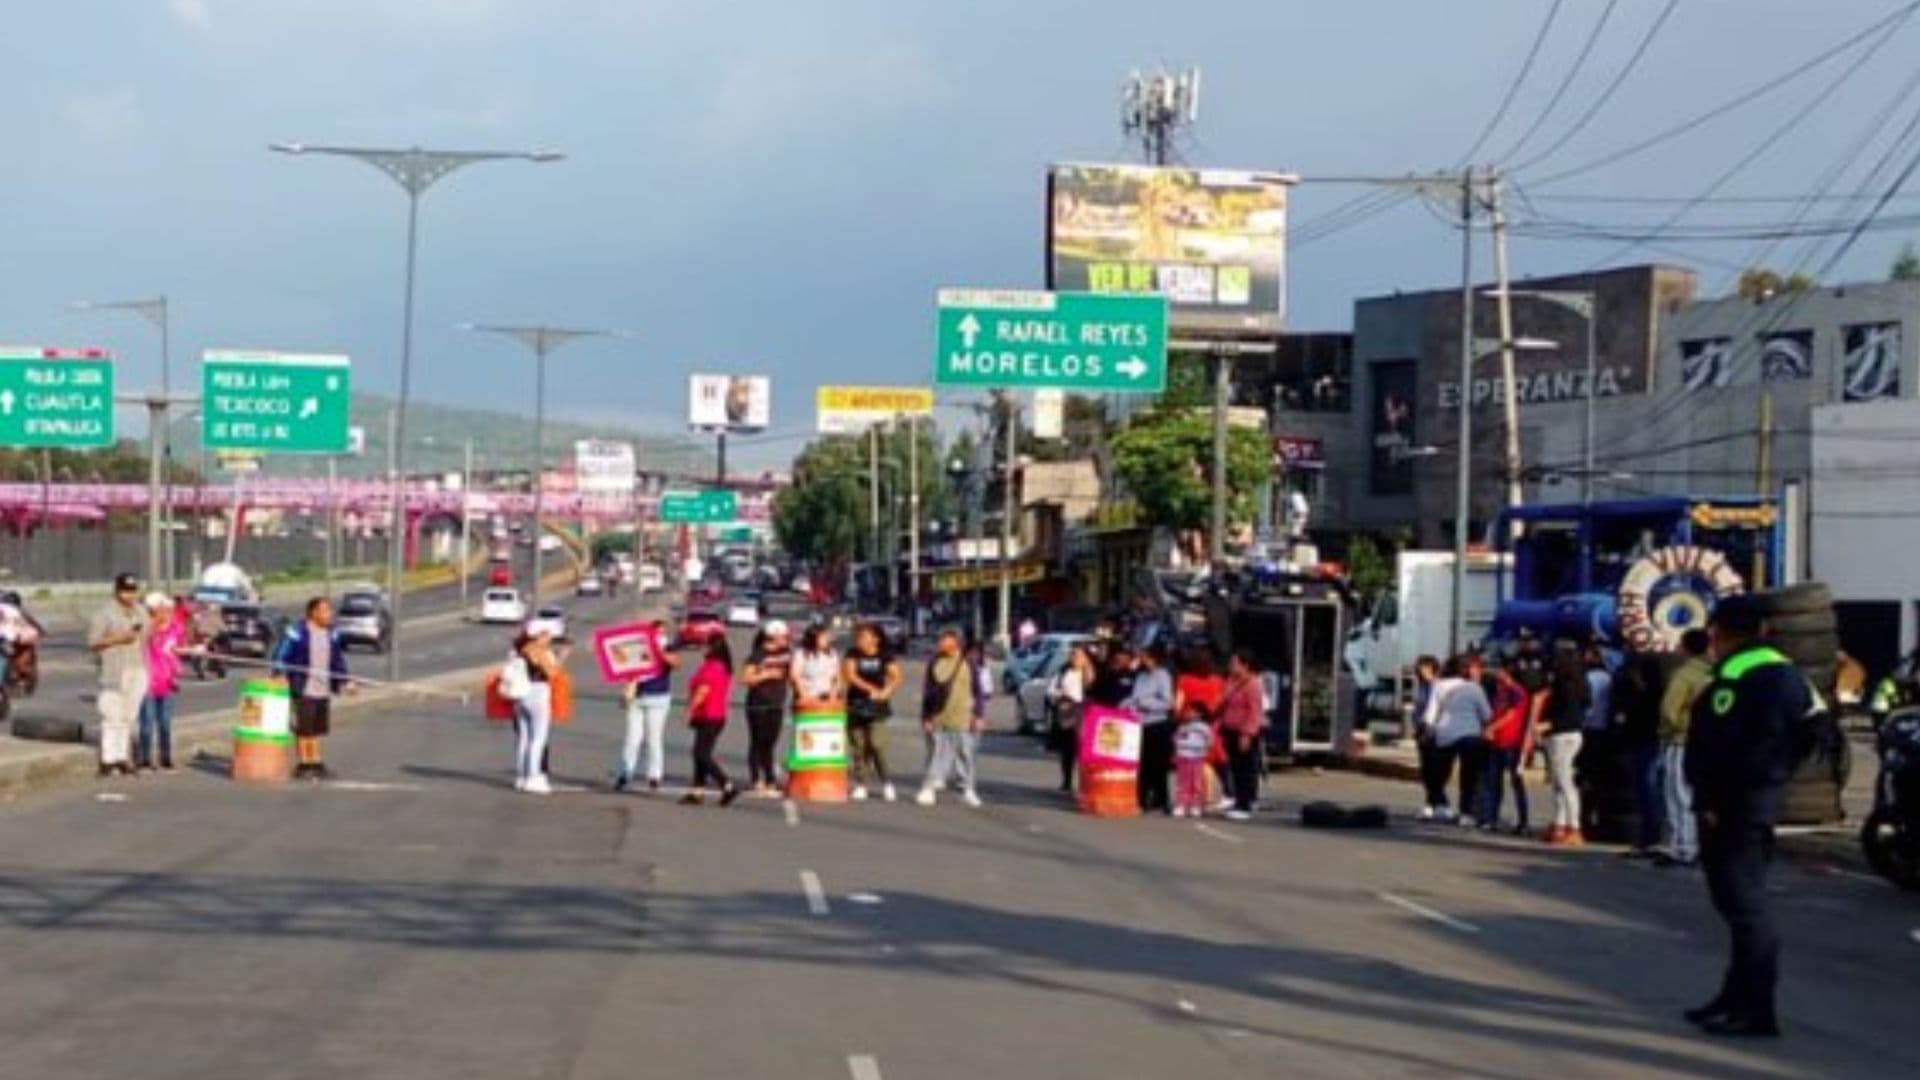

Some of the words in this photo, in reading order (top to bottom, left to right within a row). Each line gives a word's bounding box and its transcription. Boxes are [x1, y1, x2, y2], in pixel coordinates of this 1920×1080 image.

[997, 320, 1067, 344] RAFAEL
[1081, 323, 1147, 347] REYES
[950, 351, 1103, 376] MORELOS
[25, 391, 102, 411] CUAUTLA
[214, 395, 290, 414] TEXCOCO
